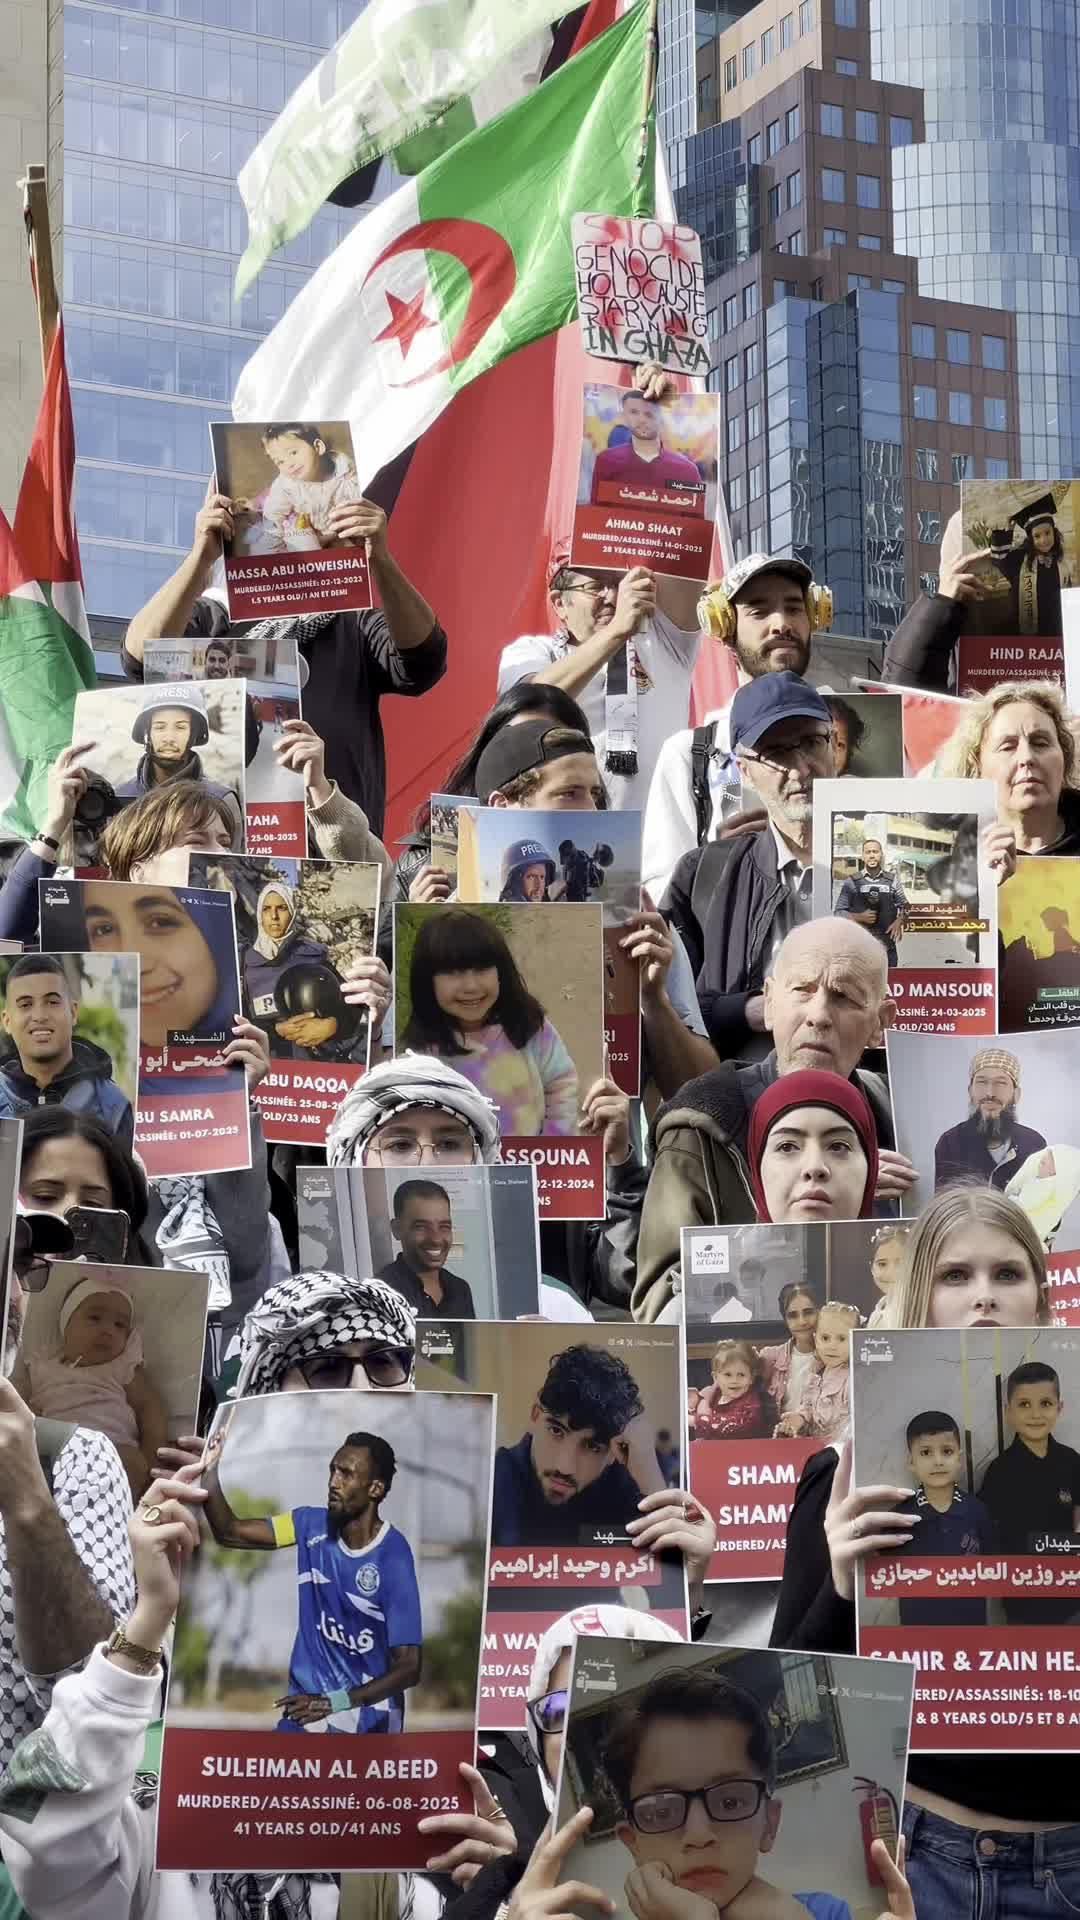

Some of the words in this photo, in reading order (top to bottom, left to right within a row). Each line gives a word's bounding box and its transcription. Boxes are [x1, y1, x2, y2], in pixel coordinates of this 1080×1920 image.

[584, 215, 696, 257] STOP
[578, 272, 705, 316] HOLOCAUSTE
[583, 326, 618, 354] IN
[624, 329, 712, 371] GHAZA
[619, 486, 659, 502] شعث
[661, 493, 697, 507] أحمد
[605, 519, 645, 532] AHMAD
[648, 522, 683, 537] SHAAT
[613, 546, 636, 556] YEARS
[637, 549, 665, 559] OLD/28
[666, 553, 681, 561] ANS
[227, 567, 269, 581] MASSA
[272, 565, 295, 576] ABU
[298, 557, 367, 574] HOWEISHAL
[321, 575, 363, 586] 02-12-2023
[263, 595, 285, 604] YEARS
[330, 589, 348, 597] DEMI
[990, 648, 1024, 660] HIND
[1029, 648, 1064, 660] RAJA
[157, 687, 190, 699] RESS
[246, 815, 280, 827] TAHA
[250, 832, 298, 842] 25-08-2025
[256, 847, 273, 855] ANS
[935, 904, 967, 914] الشهيد
[903, 921, 946, 933] منصور
[947, 920, 987, 930] محمد
[885, 983, 904, 997] AD
[909, 983, 994, 998] MANSOUR
[931, 1008, 987, 1017] 24-03-2025
[899, 1022, 935, 1032] OLD/30
[936, 1022, 956, 1031] ANS
[173, 1031, 226, 1042] الشهيدة
[146, 1046, 169, 1073] أبو
[258, 1073, 289, 1087] ABU
[293, 1075, 350, 1093] DAQQA
[160, 1108, 215, 1123] SAMRA
[262, 1110, 299, 1124] OLD/33
[301, 1114, 321, 1125] ANS
[179, 1126, 239, 1140] 01-07-2025
[498, 1148, 591, 1166] ASSOUNA
[695, 1251, 725, 1260] Martyrs
[705, 1258, 724, 1266] Gaza
[727, 1464, 800, 1486] SHAM
[719, 1504, 795, 1526] SHAM
[490, 1553, 559, 1581] إبراهيم
[562, 1558, 611, 1579] وحيد
[936, 1562, 1008, 1586] العابدين
[870, 1563, 933, 1590] حجازي
[1011, 1565, 1054, 1586] وزين
[953, 1651, 972, 1671] &
[979, 1651, 1038, 1671] ZAIN
[481, 1686, 496, 1698] 21
[916, 1713, 927, 1725] &
[930, 1713, 940, 1725] 8
[943, 1712, 987, 1725] YEARS
[991, 1712, 1034, 1726] OLD/5
[1038, 1713, 1053, 1725] ET
[1056, 1713, 1065, 1725] 8
[201, 1756, 321, 1778] SULEIMAN
[328, 1759, 358, 1779] AL
[365, 1759, 438, 1779] ABEED
[177, 1793, 360, 1810] MURDERED/ASSASSINÉ:
[365, 1796, 460, 1810] 06-08-2025
[233, 1822, 250, 1835] 41
[255, 1822, 305, 1835] YEARS
[309, 1822, 365, 1836] OLD/41
[369, 1822, 401, 1835] ANS
